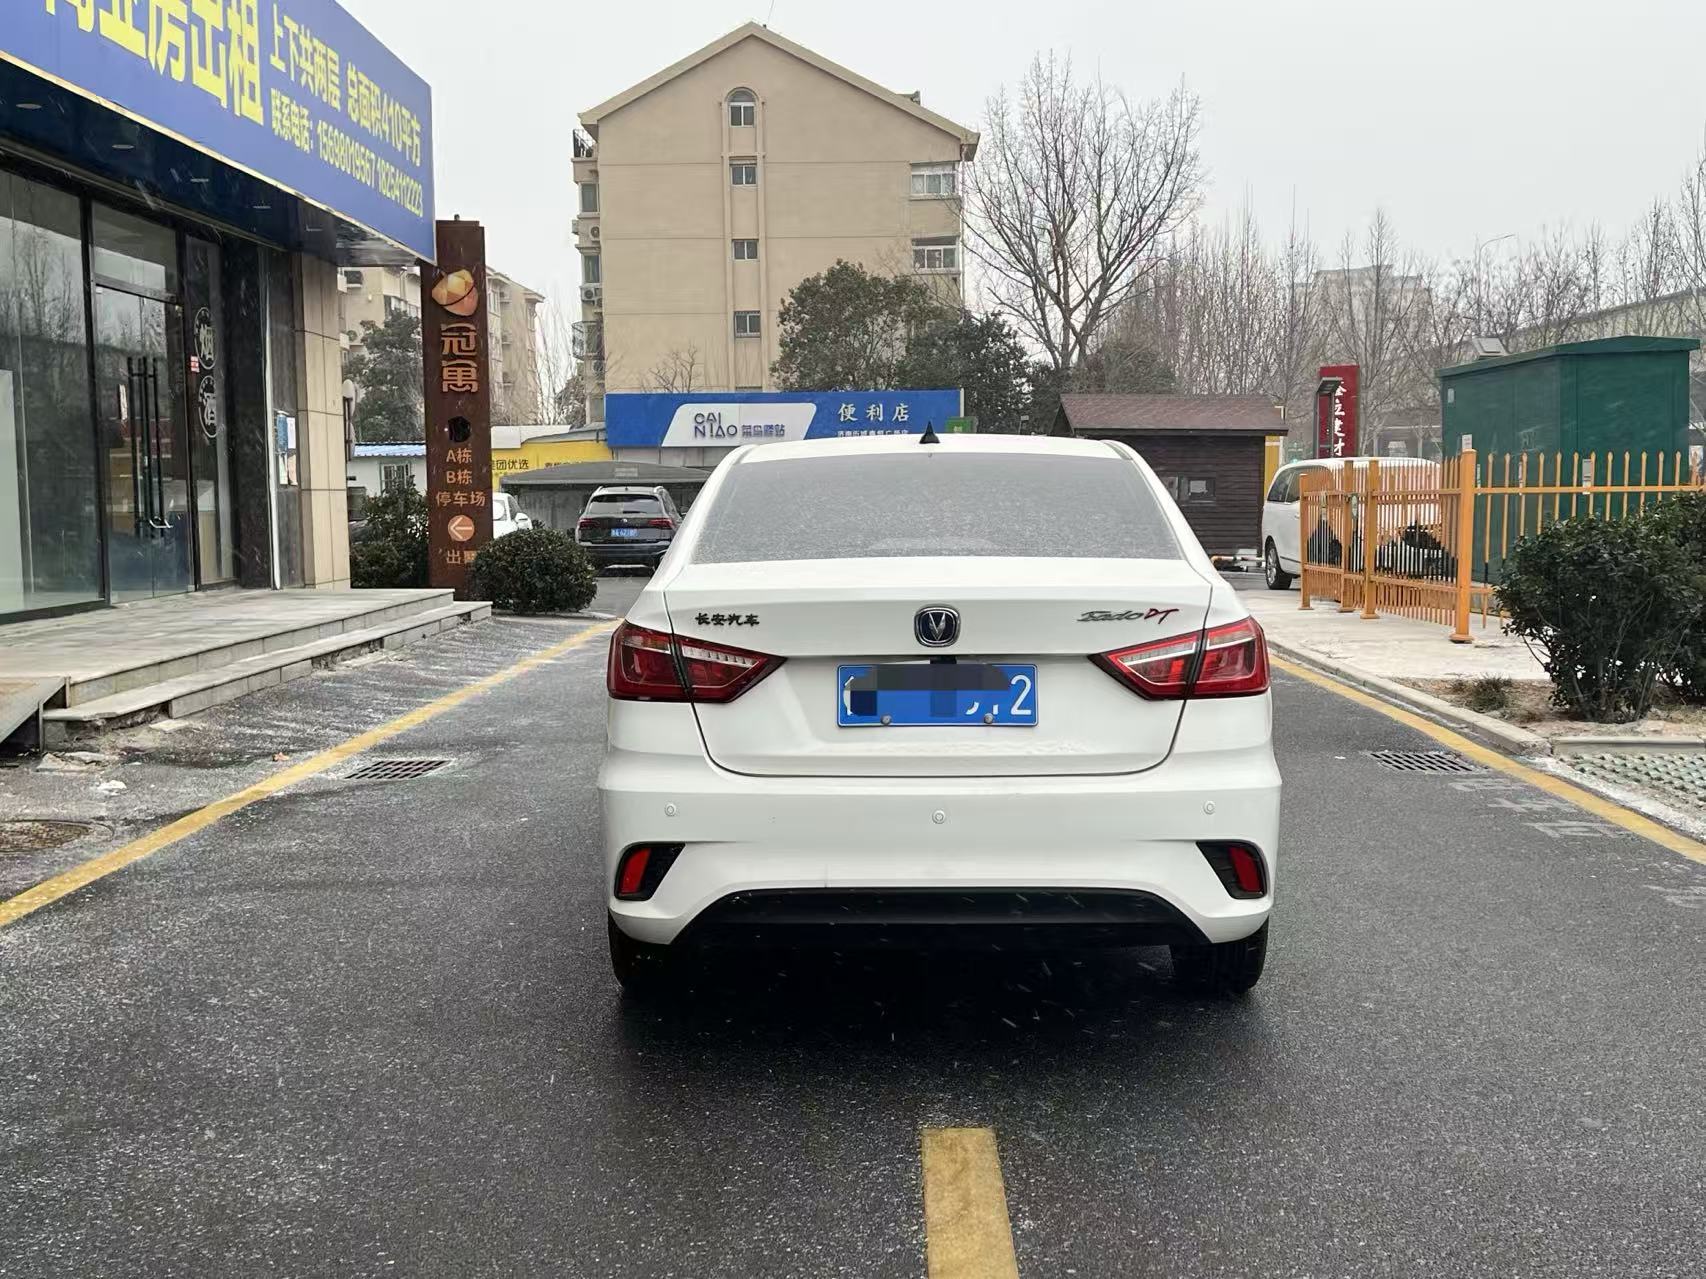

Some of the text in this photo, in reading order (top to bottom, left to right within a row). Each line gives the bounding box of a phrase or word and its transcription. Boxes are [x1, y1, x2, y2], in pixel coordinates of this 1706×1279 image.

[270, 8, 422, 167] 上下共两层 总面积410平方
[440, 323, 478, 393] 冠寓
[838, 403, 910, 422] 便利店
[446, 448, 473, 465] A栋
[446, 469, 473, 485] B栋
[435, 491, 486, 507] 停车场
[695, 612, 760, 627] 长安汽车
